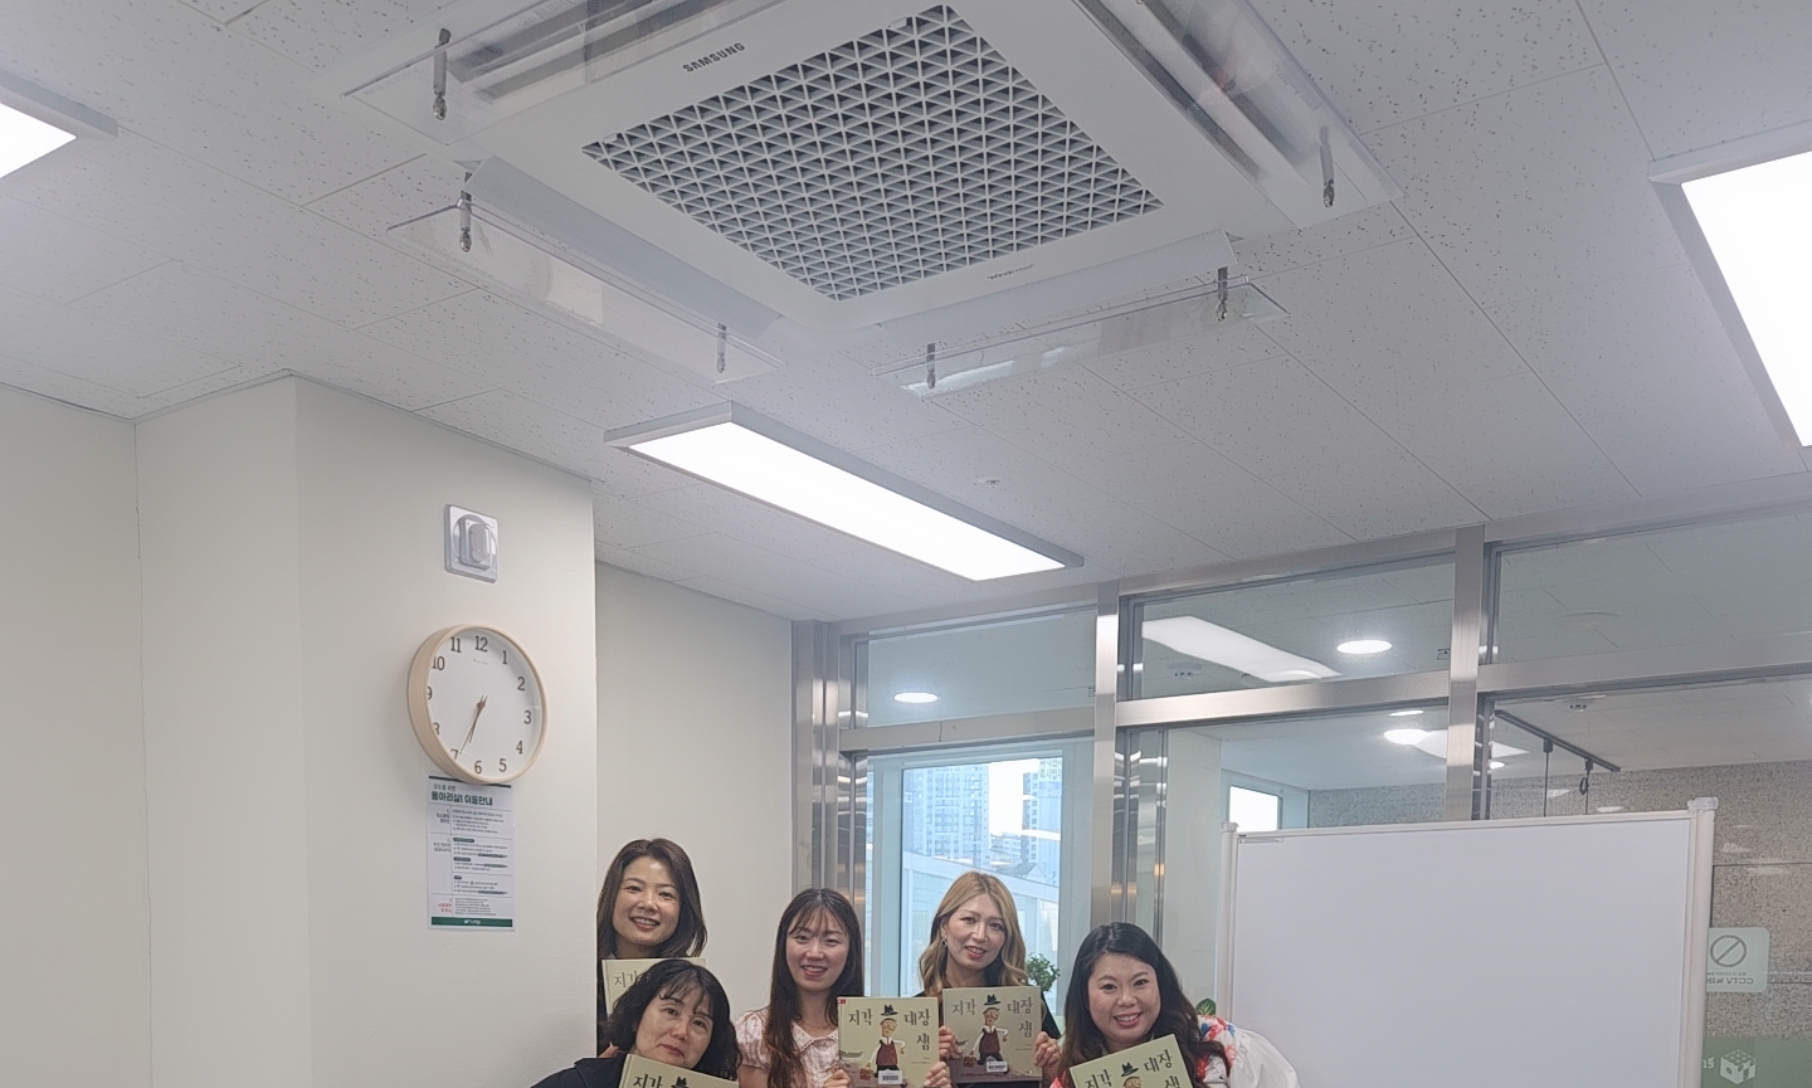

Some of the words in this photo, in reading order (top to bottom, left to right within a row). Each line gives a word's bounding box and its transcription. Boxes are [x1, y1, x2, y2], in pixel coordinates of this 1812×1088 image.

[682, 42, 745, 72] SAMSUNG
[450, 636, 462, 654] 11
[474, 635, 489, 653] 12
[432, 655, 446, 671] 10
[502, 649, 508, 665] 1
[517, 676, 526, 692] 2
[523, 709, 532, 725] 3
[450, 748, 459, 760] 7
[515, 740, 523, 755] 4
[474, 760, 483, 775] 6
[498, 757, 507, 773] 5
[952, 998, 978, 1016] 지각
[1007, 996, 1034, 1015] 대장
[848, 1008, 874, 1026] 지각
[904, 1008, 931, 1027] 대장
[1019, 1020, 1032, 1038] 샘
[916, 1033, 930, 1051] 샘
[1143, 1049, 1173, 1073] 대장
